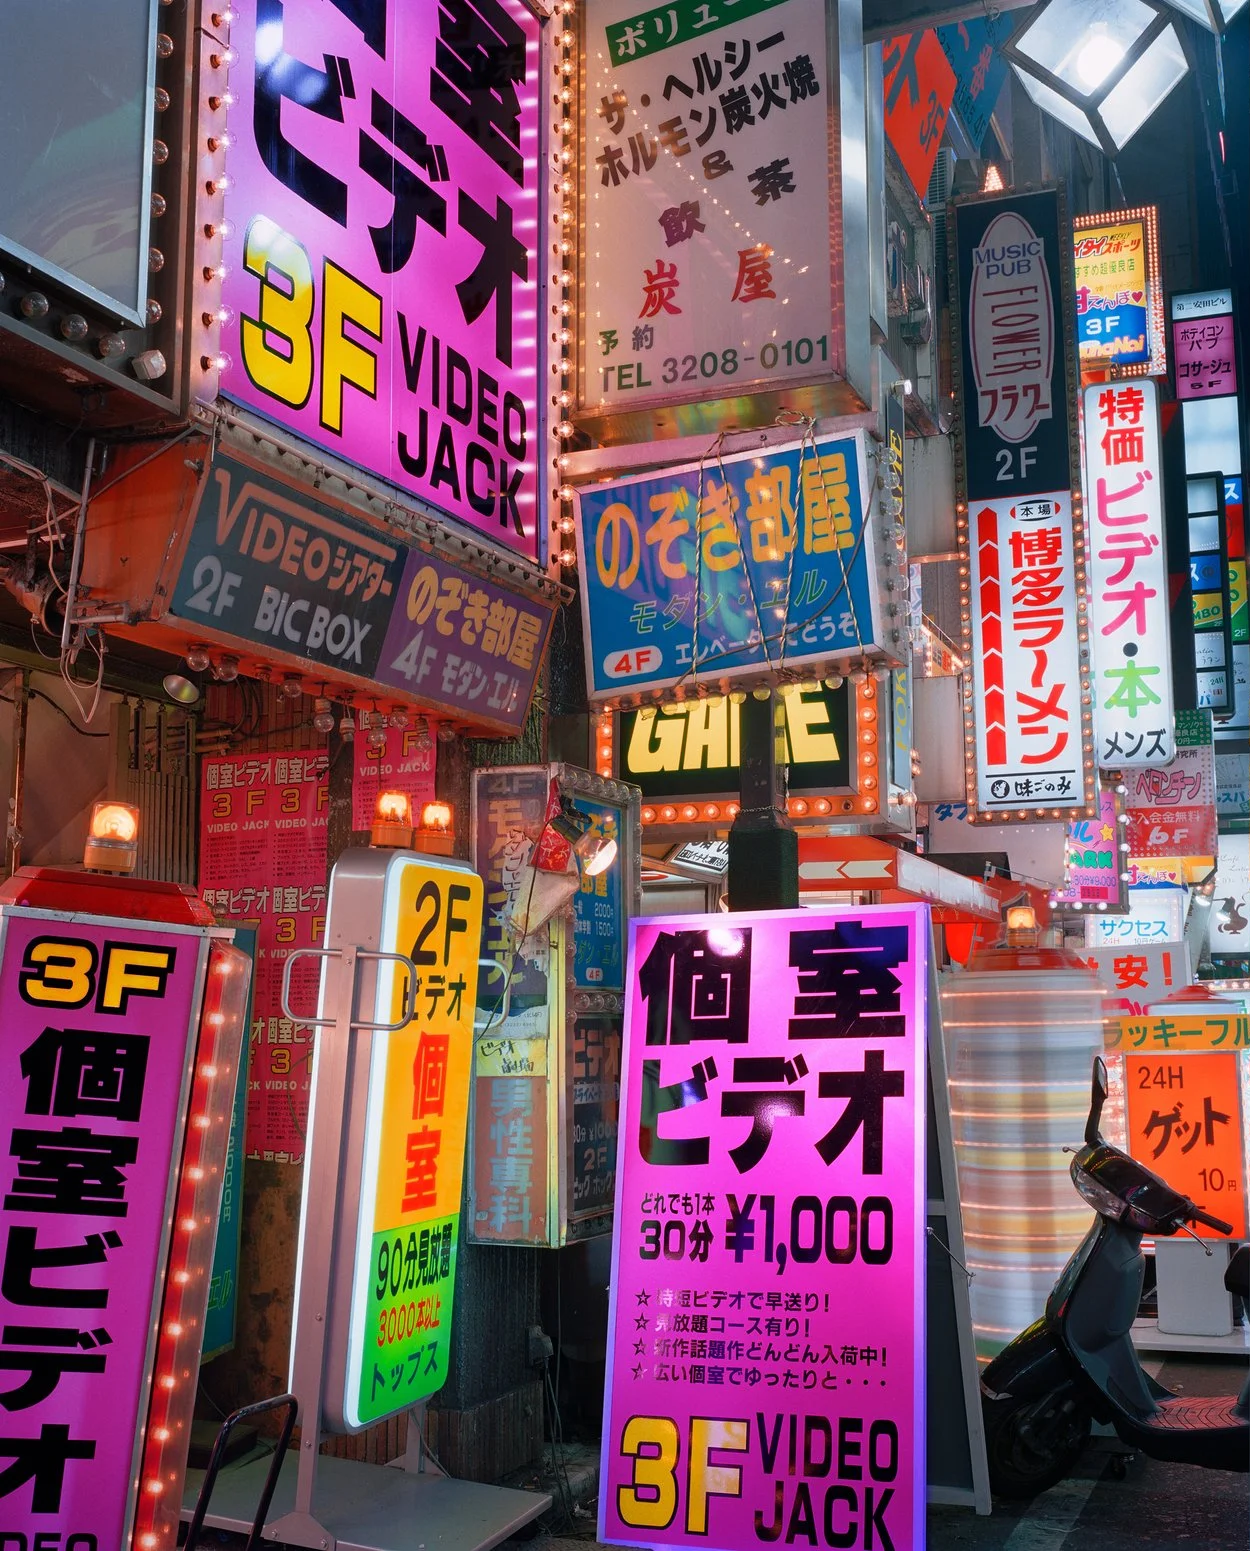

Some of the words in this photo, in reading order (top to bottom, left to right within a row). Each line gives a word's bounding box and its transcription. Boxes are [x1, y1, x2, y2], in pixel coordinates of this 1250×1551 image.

[600, 31, 786, 137] ザ・ヘルシー
[596, 54, 822, 190] ホルモン炭火焼
[253, 0, 529, 369] ビデオ
[702, 149, 735, 181] &
[973, 240, 1042, 266] MUSIC
[984, 258, 1033, 280] PUB
[241, 214, 384, 437] 3F
[982, 285, 1042, 378] FLOWER
[1085, 315, 1121, 336] 3F
[397, 310, 528, 461] VIDEO
[599, 364, 653, 393] TEL
[662, 334, 830, 385] 3208-0101
[980, 383, 1050, 425] フラワー
[397, 409, 526, 538] JACK
[995, 446, 1038, 482] 2F
[595, 452, 856, 591] のぞき部屋
[1020, 502, 1052, 519] 本場
[185, 556, 243, 618] 2F
[254, 584, 302, 643] BIC
[306, 605, 374, 665] BOX
[406, 565, 543, 673] のぞき部屋
[1233, 627, 1248, 638] 2F
[389, 629, 433, 685] 4F
[613, 649, 653, 675] 4F
[1008, 526, 1070, 766] 博多ラーメン
[627, 683, 841, 774] GAE
[1104, 729, 1167, 762] メンズ
[206, 758, 272, 791] 個室ビデオ
[360, 764, 393, 777] VIDEO
[396, 761, 431, 773] JACK
[207, 822, 239, 834] VIDEO
[274, 817, 308, 830] VIDEO
[1137, 811, 1201, 825] 入会金無料
[1148, 825, 1189, 846] 6F
[411, 879, 472, 968] 2F
[1099, 919, 1169, 938] サクセス
[18, 934, 177, 1017] 3F
[638, 921, 910, 1047] 個室
[265, 1080, 298, 1091] VIDEO
[1138, 1065, 1185, 1090] 24H
[401, 1029, 446, 1214] 個室
[638, 1049, 906, 1177] ビデオ
[1142, 1096, 1233, 1162] ゲット
[489, 1077, 534, 1236] 男性専科
[639, 1219, 715, 1264] 30分
[724, 1193, 894, 1277] ¥1,000
[640, 1193, 716, 1216] どれでも1本
[0, 1026, 152, 1515] 個室ビデオ
[376, 1222, 453, 1301] 90分見放題
[376, 1294, 441, 1348] 3000本以上
[371, 1340, 439, 1403] トップス
[615, 1413, 751, 1538] 3F
[756, 1412, 900, 1483] VIDEO
[754, 1480, 896, 1551] JACK
